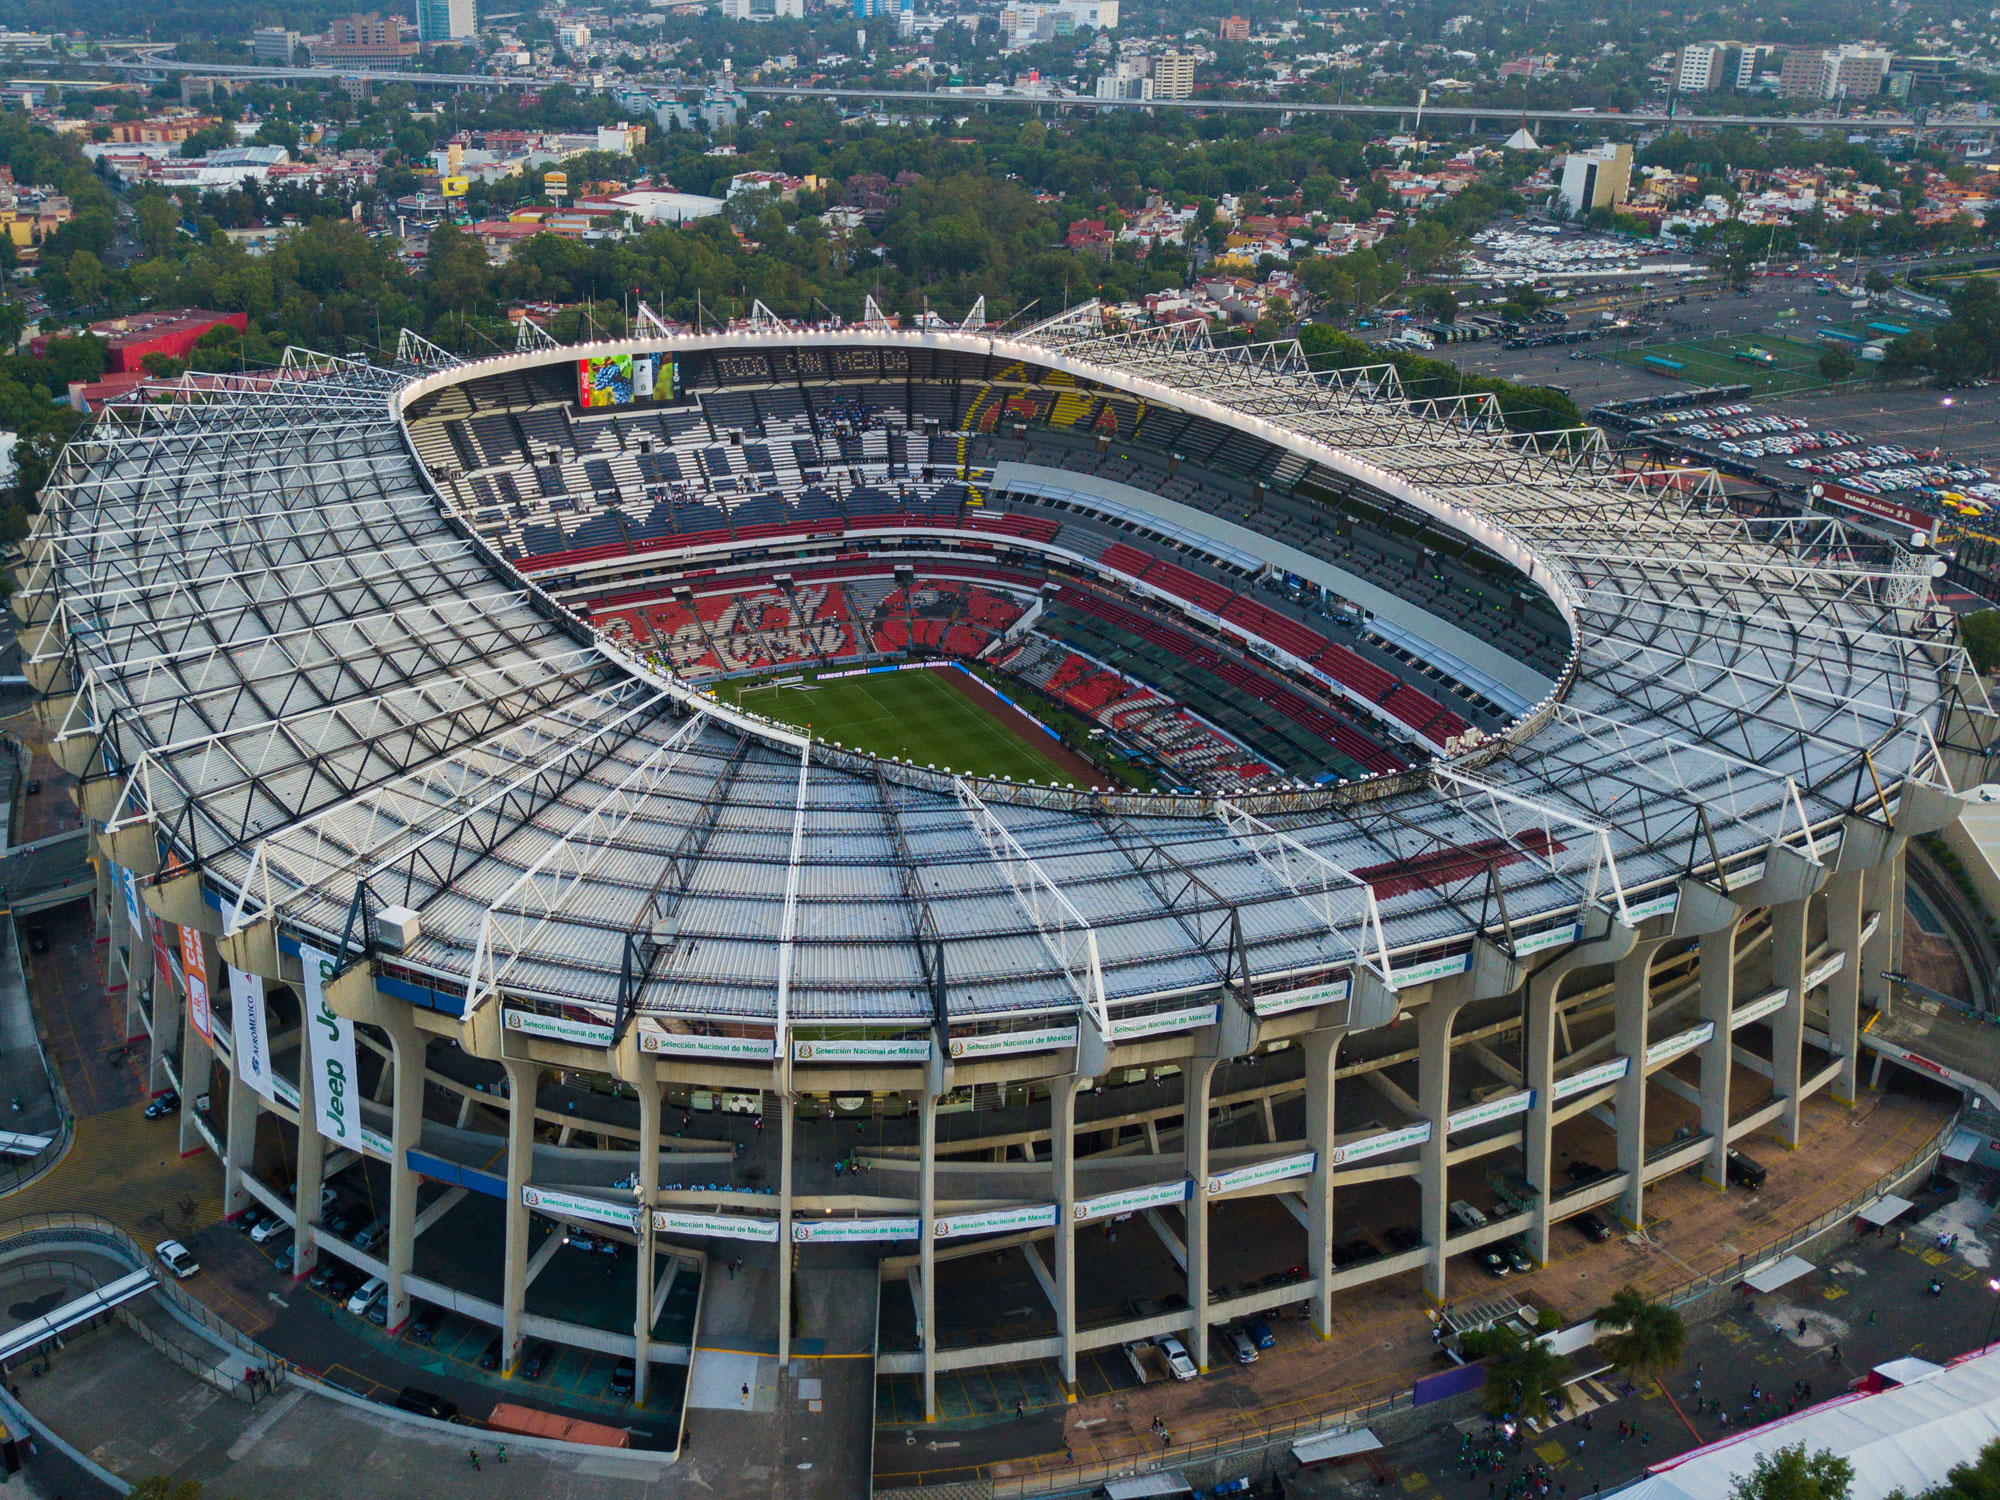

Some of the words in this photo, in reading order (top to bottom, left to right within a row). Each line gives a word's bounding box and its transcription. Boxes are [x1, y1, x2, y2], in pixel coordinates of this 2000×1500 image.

[1844, 493, 1870, 506] Estadio
[1870, 501, 1894, 514] Azteca
[817, 671, 843, 680] FAMOUS
[843, 669, 867, 677] AMONG
[1408, 968, 1433, 979] Nacional
[1442, 961, 1463, 972] México
[1882, 972, 1901, 982] RAMPA
[1283, 994, 1311, 1005] Nacional
[1311, 992, 1320, 1000] de
[1321, 988, 1343, 998] México
[523, 1019, 555, 1031] Selección
[557, 1027, 587, 1037] Nacional
[588, 1031, 597, 1039] de
[1113, 1024, 1147, 1034] Selección
[1147, 1018, 1177, 1029] Nacional
[1178, 1016, 1187, 1024] de
[1188, 1012, 1212, 1021] México
[661, 1040, 696, 1049] Selección
[698, 1043, 730, 1052] Nacional
[731, 1044, 741, 1052] de
[742, 1045, 769, 1054] México
[815, 1047, 851, 1055] Selección
[853, 1047, 886, 1055] Nacional
[887, 1047, 897, 1055] de
[898, 1046, 925, 1054] México
[967, 1042, 1001, 1051] Selección
[1003, 1038, 1034, 1047] Nacional
[1046, 1034, 1072, 1043] México
[326, 1058, 347, 1138] Jeep
[1479, 1107, 1500, 1117] Nacional
[1348, 1145, 1374, 1156] Selección
[1375, 1138, 1399, 1149] Nacional
[1408, 1131, 1427, 1139] México
[1224, 1175, 1253, 1186] Selección
[1254, 1168, 1280, 1178] Nacional
[1289, 1162, 1311, 1170] México
[542, 1197, 573, 1209] Selección
[574, 1203, 602, 1214] Nacional
[613, 1210, 631, 1220] Méxi
[1090, 1201, 1120, 1212] Selección
[1122, 1195, 1150, 1205] Nacional
[1160, 1190, 1183, 1199] México
[670, 1219, 704, 1229] Selección
[705, 1222, 736, 1232] Nacional
[747, 1226, 773, 1235] México
[952, 1221, 985, 1231] Selección
[986, 1217, 1016, 1227] Nacional
[1028, 1213, 1052, 1222] México
[813, 1228, 846, 1236] Selección
[848, 1227, 878, 1235] Nacional
